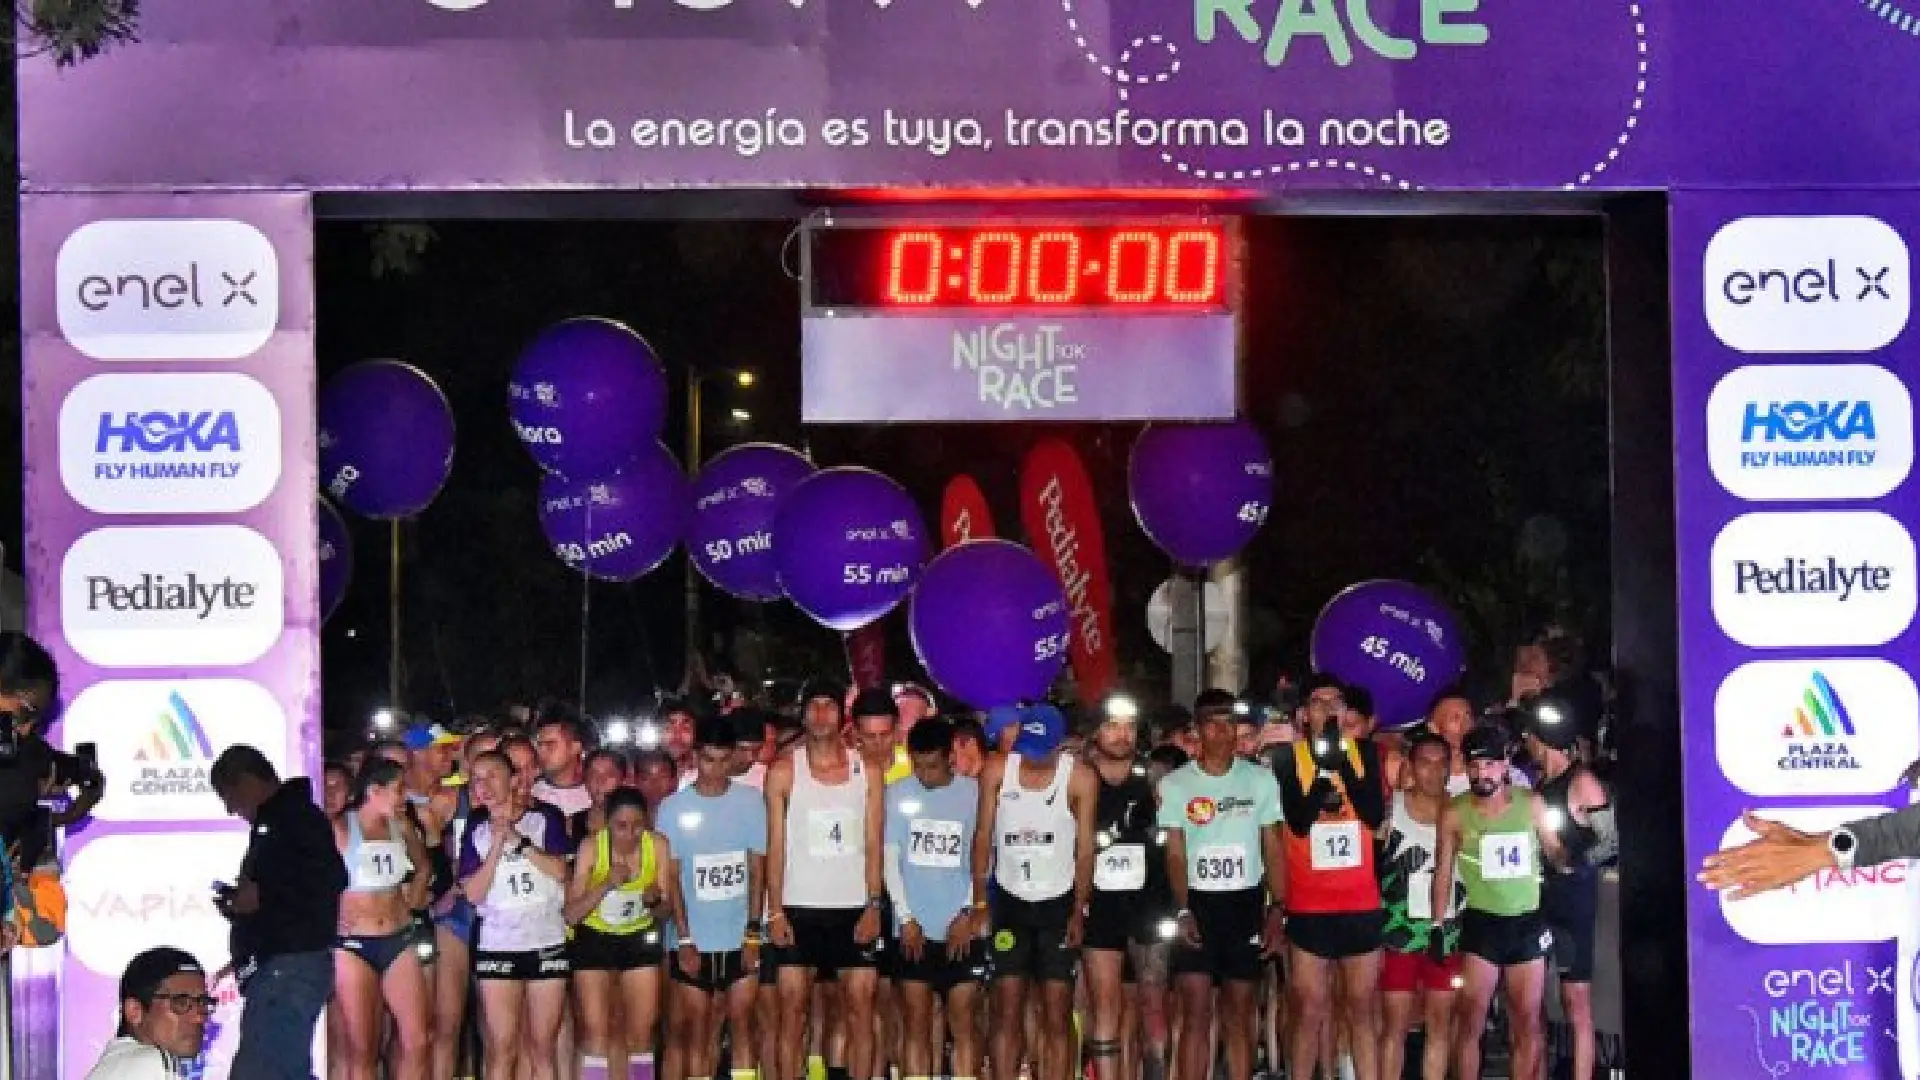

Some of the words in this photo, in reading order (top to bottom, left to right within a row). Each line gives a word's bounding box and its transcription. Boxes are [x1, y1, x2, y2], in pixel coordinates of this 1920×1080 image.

[565, 109, 616, 147] La
[630, 108, 806, 156] energía
[821, 115, 869, 147] es
[884, 109, 993, 156] tuya,
[1005, 109, 1249, 147] transforma
[1263, 109, 1304, 147] la
[1319, 109, 1451, 147] noche
[76, 261, 203, 311] enel
[1723, 258, 1840, 305] enel
[952, 322, 1063, 370] NIGHT
[978, 363, 1078, 409] RACE
[94, 409, 241, 453] HOKA
[1741, 400, 1876, 442] HOKA
[94, 462, 127, 479] FLY
[130, 462, 205, 479] HUMAN
[210, 462, 241, 479] FLY
[1741, 451, 1770, 468] FLY
[1773, 451, 1844, 468] HUMAN
[1847, 451, 1876, 468] FLY
[705, 539, 732, 563] 50
[843, 562, 872, 584] 55
[875, 562, 910, 584] min
[1733, 556, 1892, 601] Pedialyte
[84, 573, 257, 619] Pedialyte
[1360, 636, 1389, 660] 45
[1789, 742, 1849, 755] PLAZA
[141, 767, 206, 780] PLAZA
[1777, 756, 1861, 770] CENTRAL
[829, 823, 842, 843] 4
[910, 831, 961, 856] 7632
[1325, 835, 1350, 857] 12
[1495, 846, 1520, 867] 14
[372, 853, 395, 875] 11
[695, 863, 745, 889] 7625
[1020, 859, 1032, 881] 1
[1197, 856, 1245, 879] 6301
[507, 872, 535, 895] 15
[79, 886, 207, 924] VAPIA
[1764, 959, 1855, 997] enel
[1770, 1000, 1854, 1038] NIGHT
[1790, 1031, 1865, 1067] RACE
